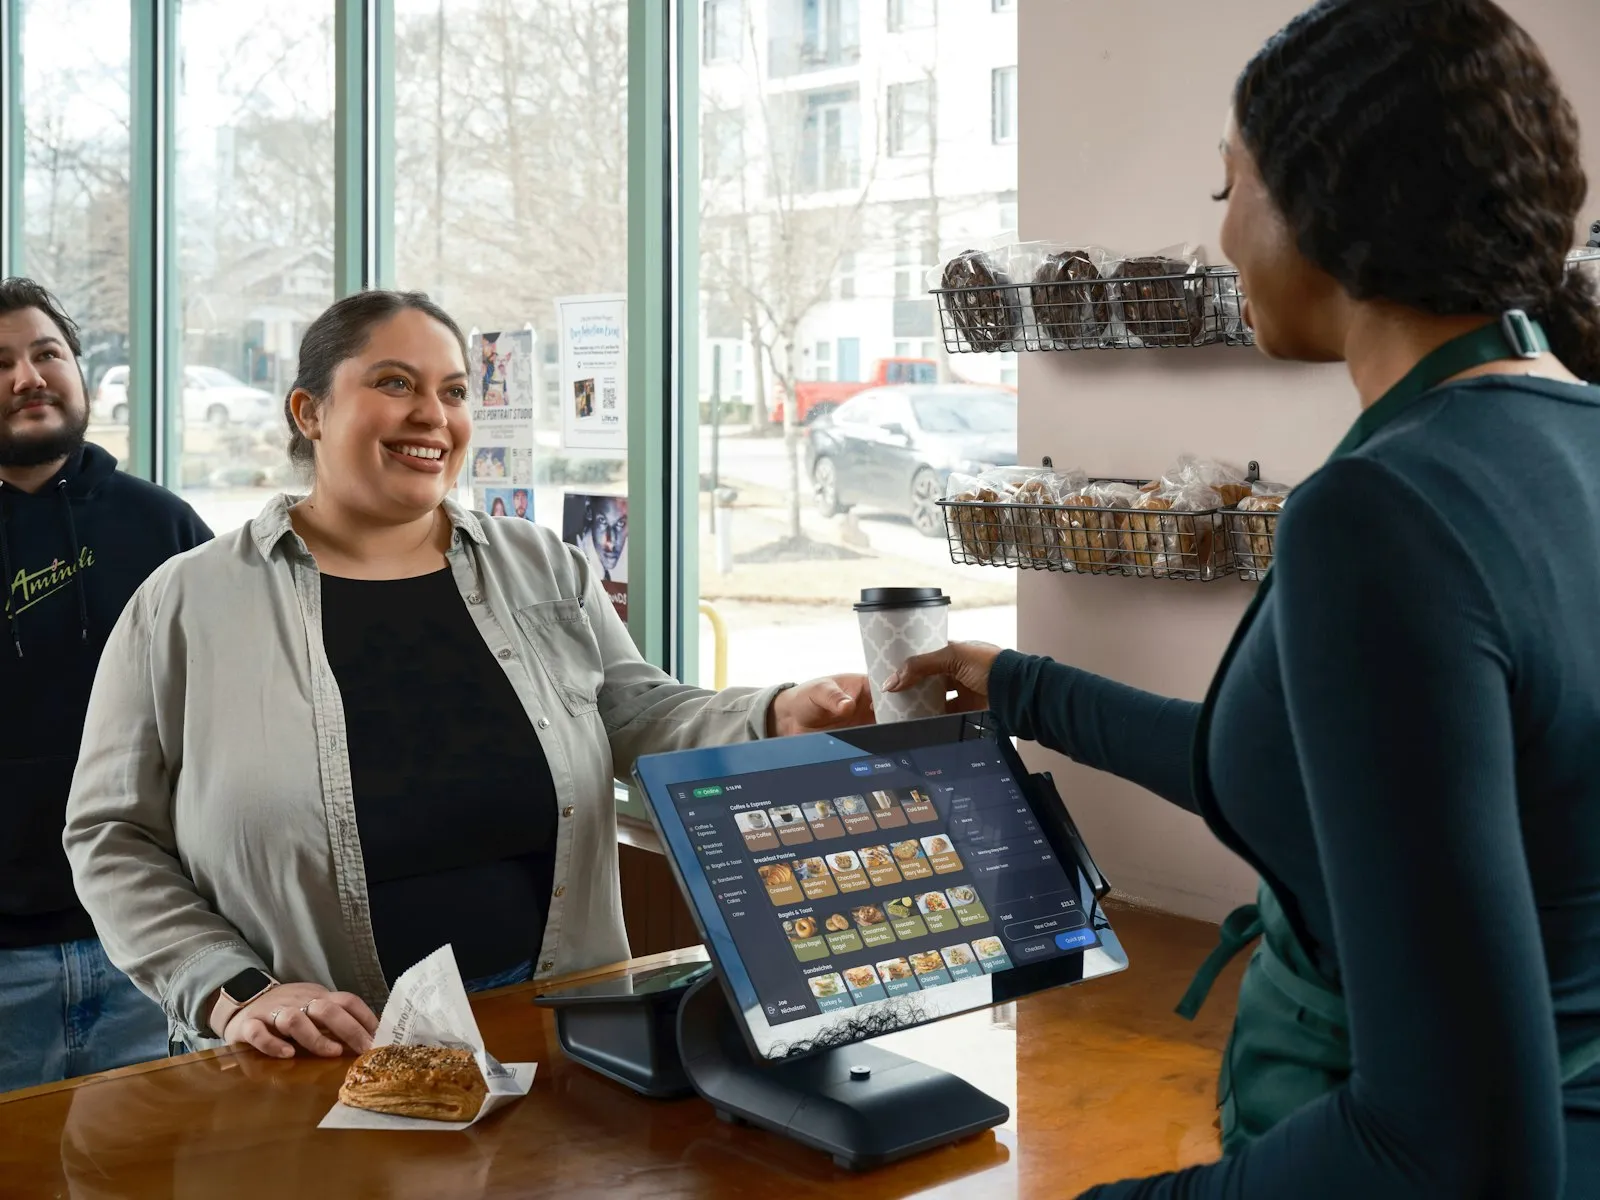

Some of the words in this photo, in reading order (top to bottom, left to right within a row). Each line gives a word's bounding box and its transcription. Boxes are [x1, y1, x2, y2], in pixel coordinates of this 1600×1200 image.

[750, 800, 771, 808] Espresso
[780, 826, 805, 834] Americano
[753, 855, 777, 864] Breakfast
[717, 875, 743, 883] Sandwiches
[778, 911, 796, 919] Bagels
[829, 933, 855, 943] Everything
[807, 939, 822, 947] Bagel
[1025, 944, 1045, 953] Checkout
[803, 964, 833, 975] Sandwiches
[921, 975, 940, 983] Chicken
[780, 1004, 806, 1014] Nicholson
